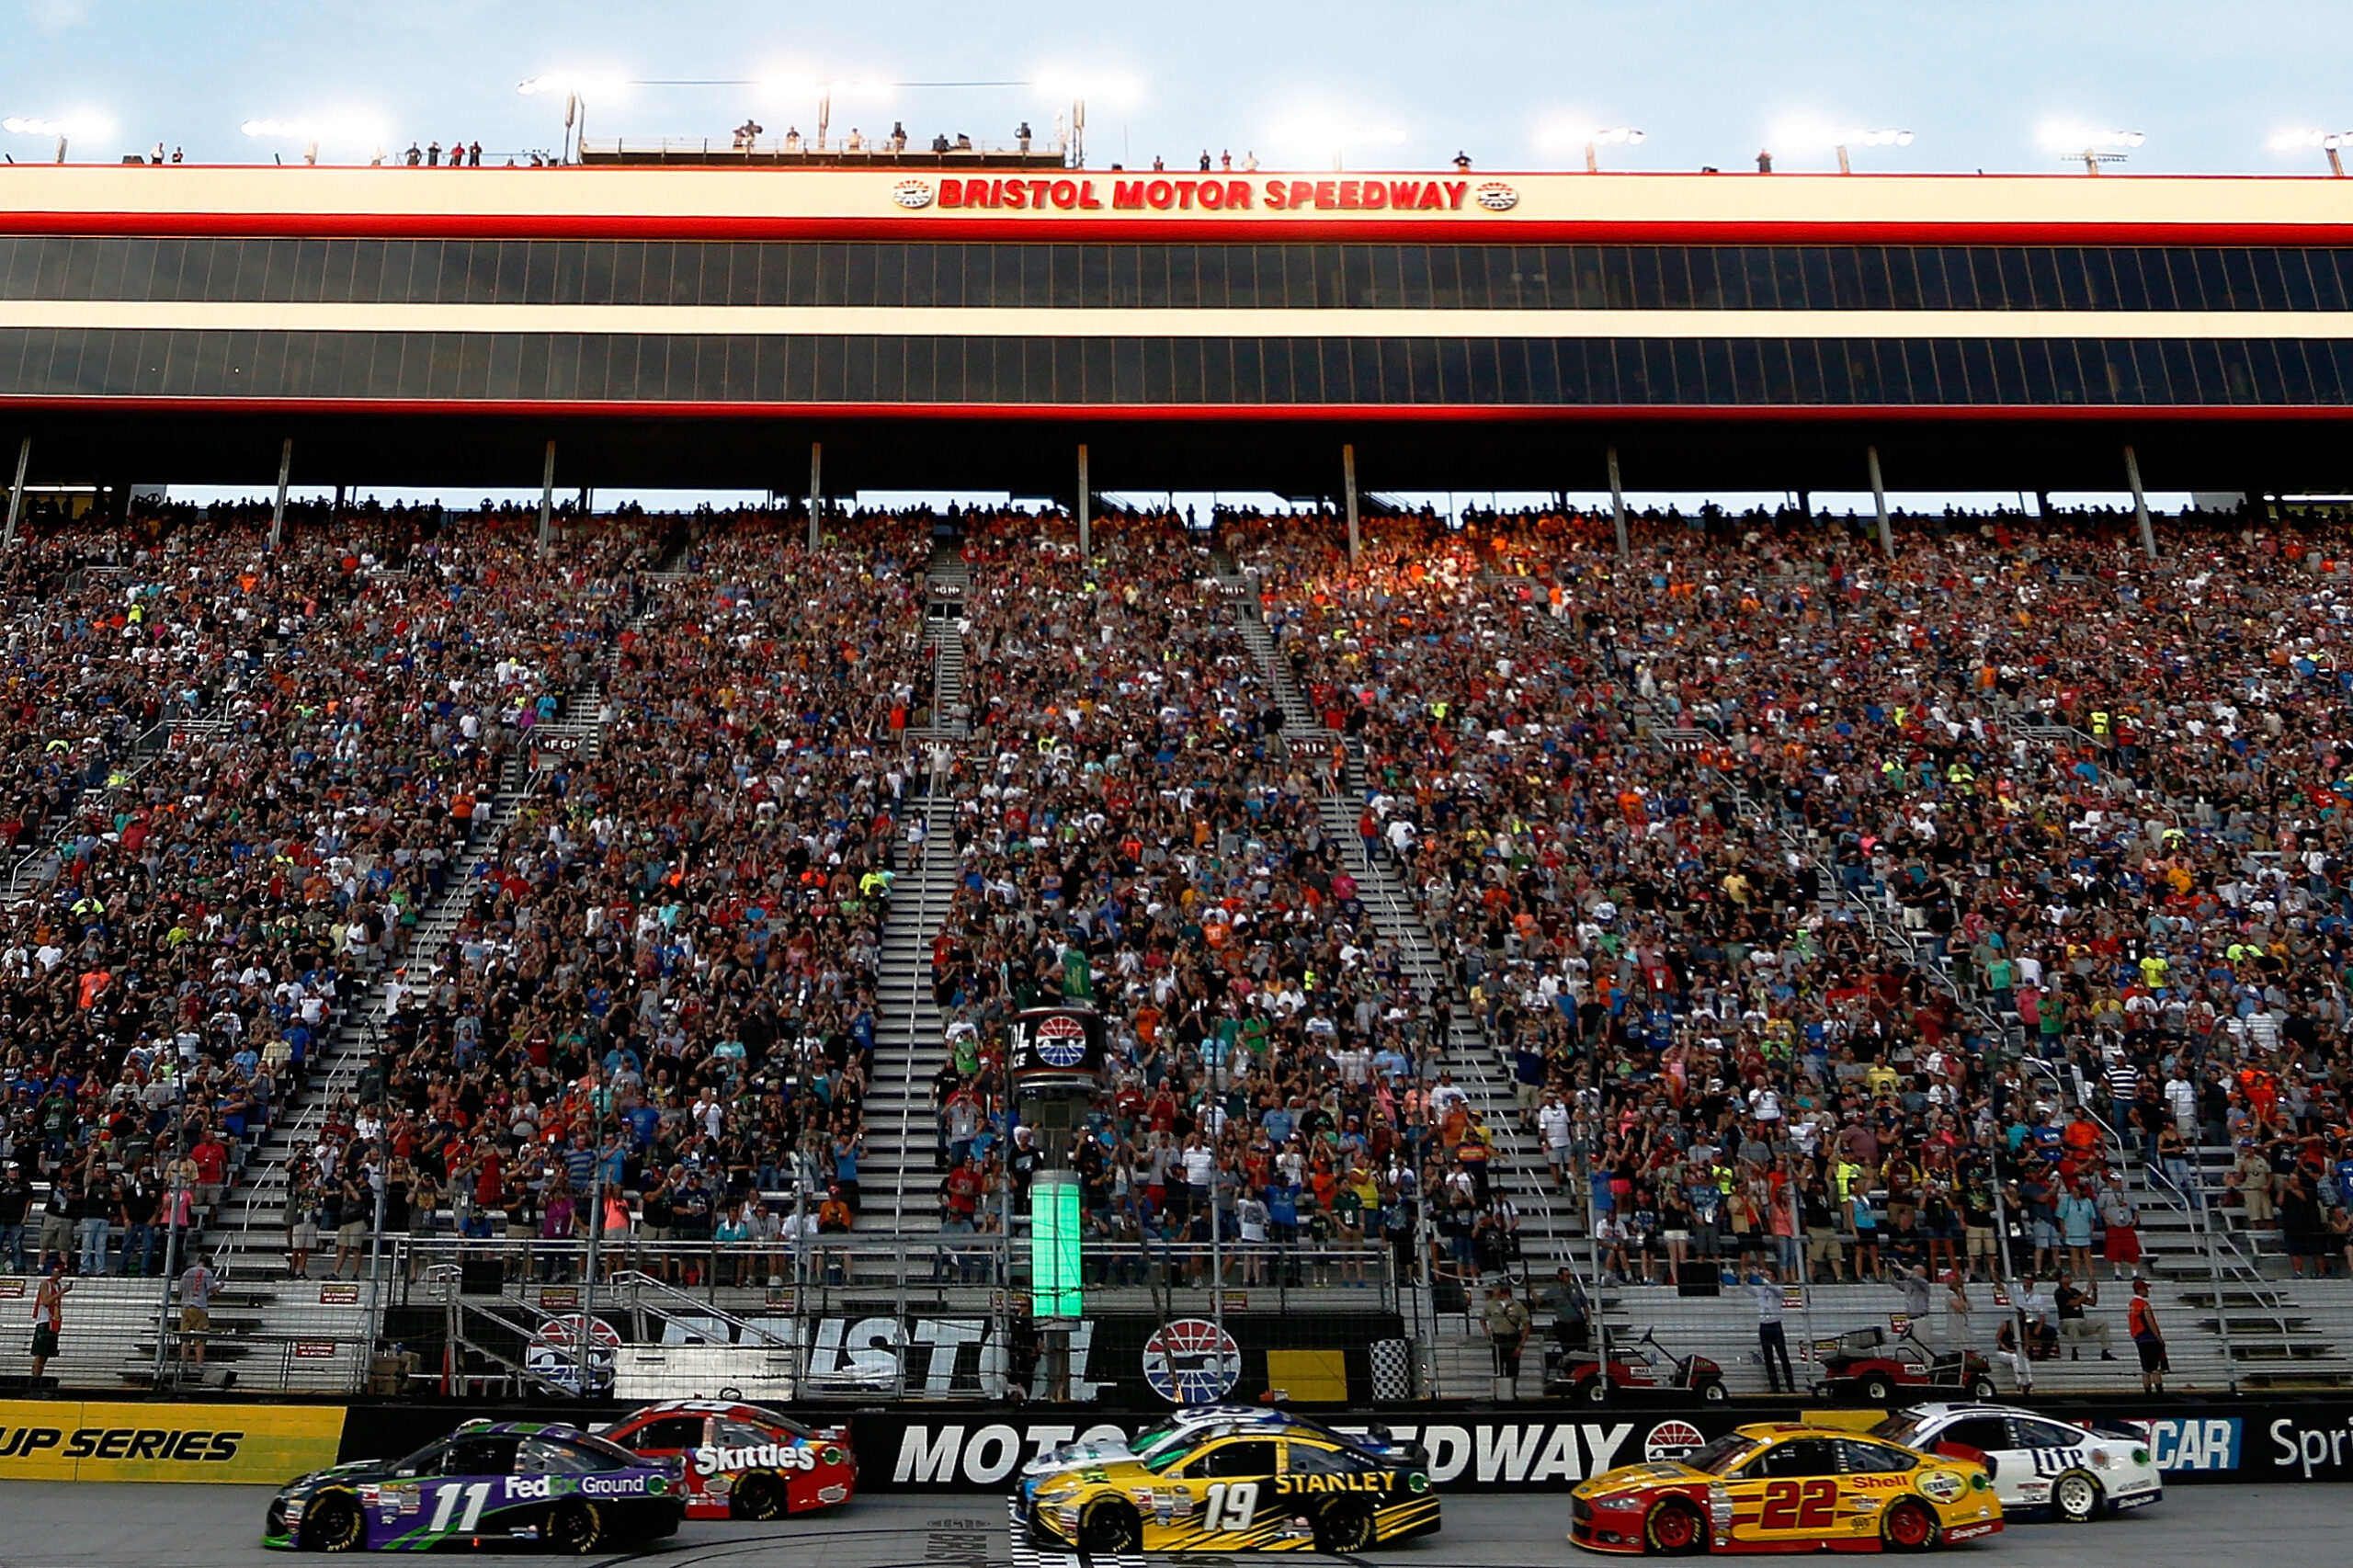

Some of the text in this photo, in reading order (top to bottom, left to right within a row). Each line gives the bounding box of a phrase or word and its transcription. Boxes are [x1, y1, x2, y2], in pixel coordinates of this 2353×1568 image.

[937, 178, 1468, 210] BRISTOL MOTOR SPEEDWAY
[63, 1428, 244, 1461] SERIES
[695, 1443, 815, 1475] Skittles
[892, 1424, 1175, 1483] MOT
[506, 1474, 643, 1499] FedEx Ground
[1274, 1471, 1397, 1494] STANLEY
[1852, 1474, 1908, 1489] Shell
[429, 1483, 493, 1532] 11
[1203, 1482, 1259, 1531] 19
[1759, 1479, 1838, 1529] 22
